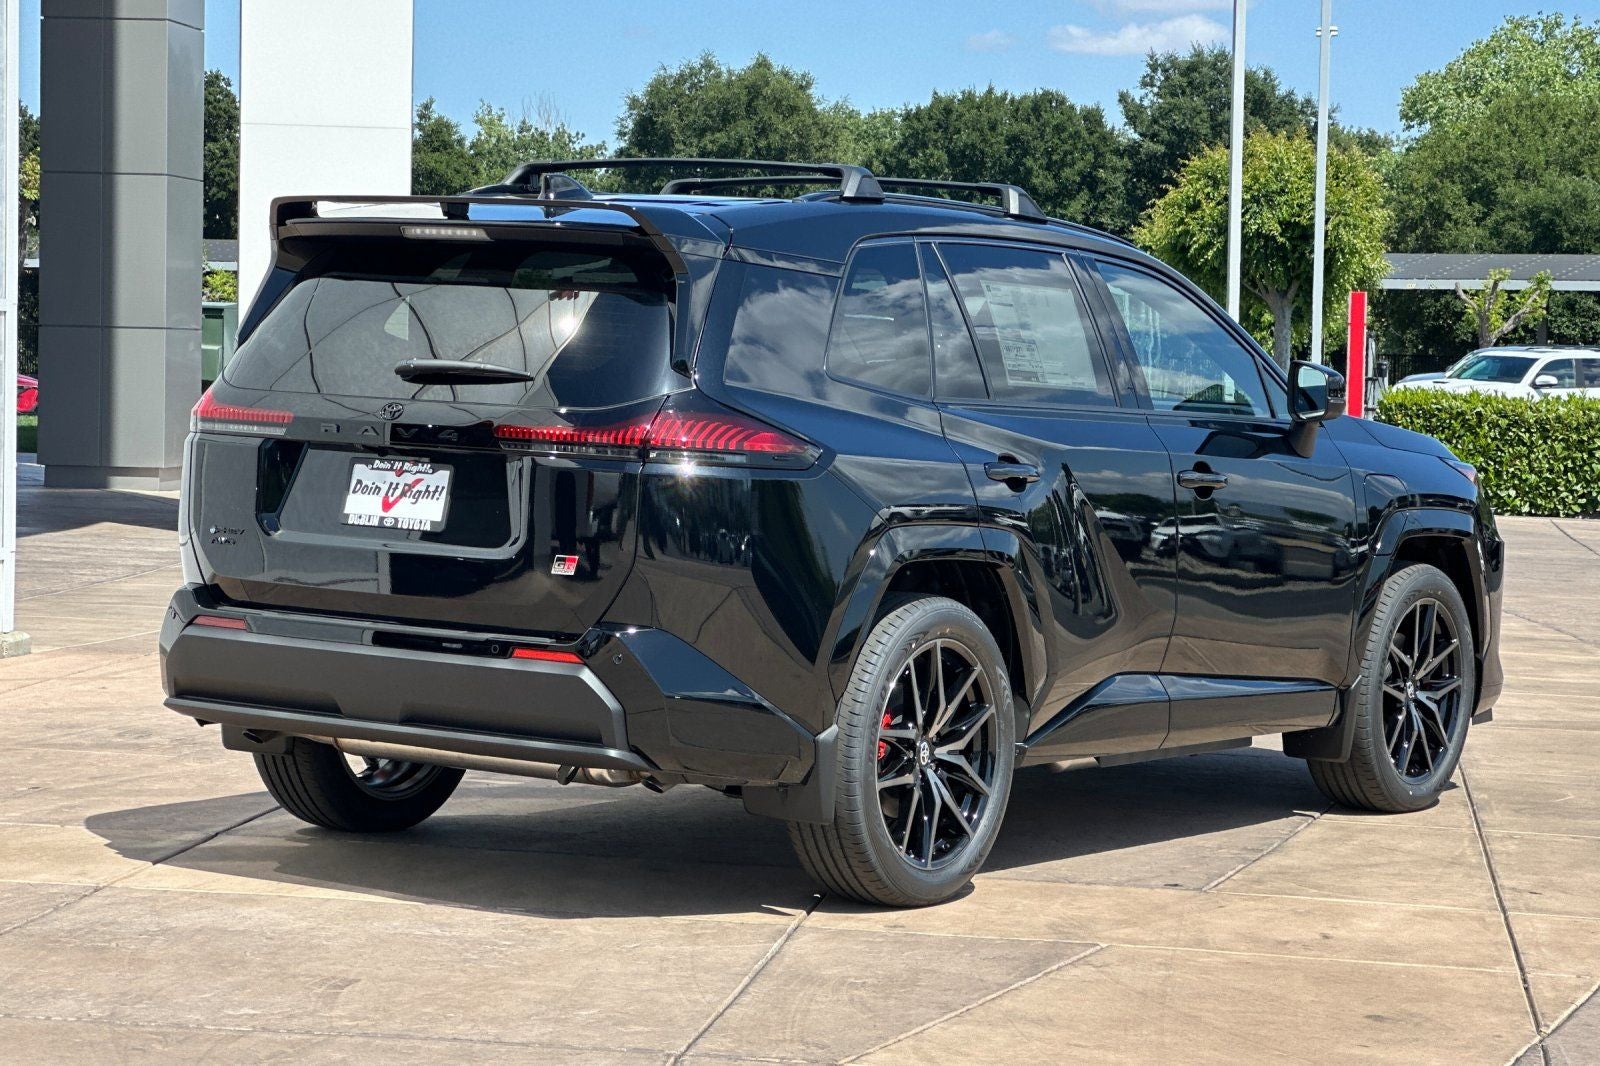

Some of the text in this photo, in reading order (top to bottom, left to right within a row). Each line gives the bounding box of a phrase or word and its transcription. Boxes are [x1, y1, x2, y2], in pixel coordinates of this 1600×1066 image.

[320, 422, 459, 441] RAV4
[373, 459, 431, 475] Doin' It Right!
[352, 479, 446, 505] Doin' It Right!
[347, 513, 431, 531] DUBLIN TOYOTA
